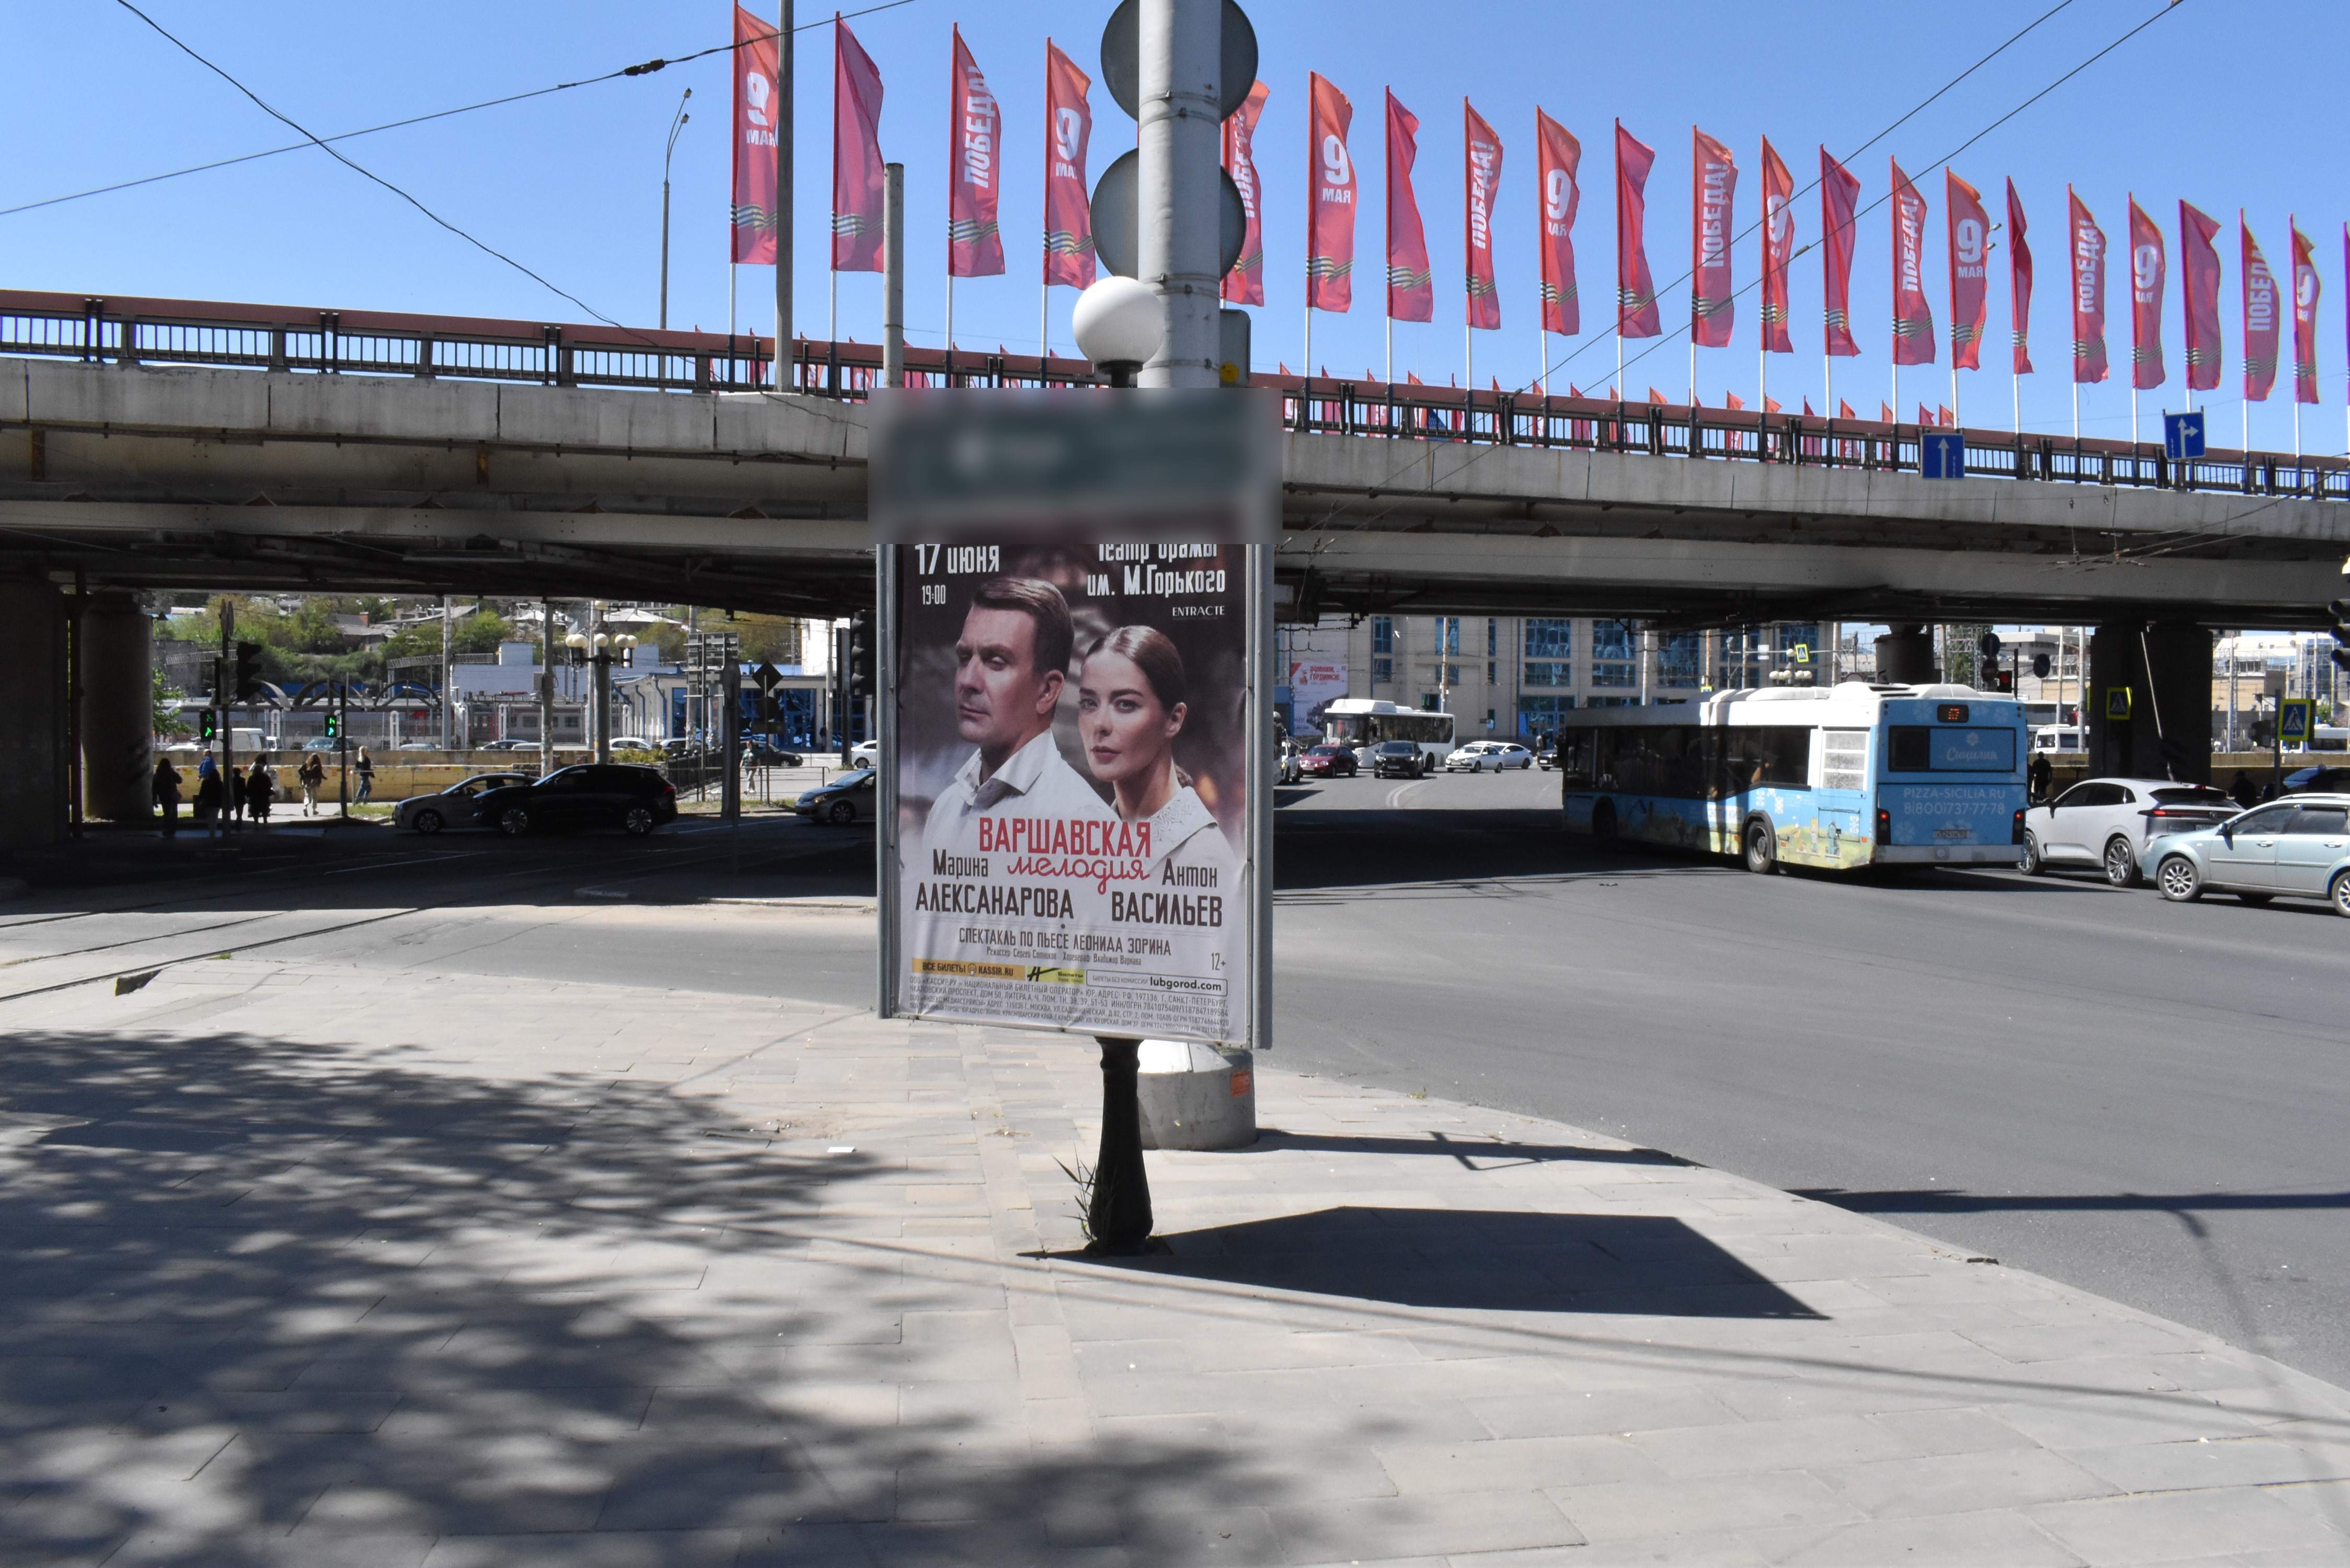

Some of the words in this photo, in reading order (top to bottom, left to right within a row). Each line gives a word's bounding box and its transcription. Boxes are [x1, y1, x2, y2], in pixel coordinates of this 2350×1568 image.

[747, 72, 769, 125] 9
[1056, 108, 1081, 161] 9
[1056, 162, 1077, 179] МА
[1323, 134, 1349, 185] 9
[1322, 188, 1351, 203] МАЯ
[1471, 141, 1494, 249] ПОБЕДА!
[1547, 169, 1571, 220] 9
[1701, 163, 1729, 267] ПОБЕДА!
[1767, 194, 1789, 243] 9
[1899, 194, 1919, 292] ПОБЕДА!
[1957, 218, 1982, 263] 9
[1958, 266, 1983, 278] МАЯ
[2135, 245, 2157, 289] 9
[915, 544, 941, 576] 17
[947, 545, 999, 574] июня
[921, 584, 946, 605] 19:00
[1087, 574, 1115, 597] им.
[1124, 564, 1226, 597] М.Горького
[1172, 605, 1225, 617] ENTRACTE
[1904, 788, 2006, 799] PIZZA-SICILIA.RU
[979, 817, 1150, 858] ВАРШАВСКАЯ
[932, 848, 989, 880] Марина
[1007, 856, 1150, 894] мелодия
[1162, 858, 1217, 888] Антон
[916, 882, 1074, 919] АЛЕКСАНДРОВА
[1111, 891, 1223, 927] ВАСИЛЬЕВ
[959, 927, 1016, 947] СПЕКТАКЛЬ
[1020, 930, 1033, 948] ПО
[1037, 931, 1069, 950] ПЬЕСЕ
[1073, 933, 1123, 953] ЛЕОНИДА
[1128, 937, 1171, 956] ЗОРИНА
[923, 962, 935, 971] ВСЕ
[937, 963, 966, 973] БИЛЕТЫ
[978, 966, 1013, 976] KASSIR.RU
[1211, 953, 1226, 971] 12+
[964, 980, 1013, 990] НАЦИОНАЛЬНЫЙ
[1015, 984, 1047, 993] БИЛЕТНЫЙ
[1150, 976, 1222, 991] lubgorod.com
[1111, 1000, 1142, 1009] ИНН/ОГРН
